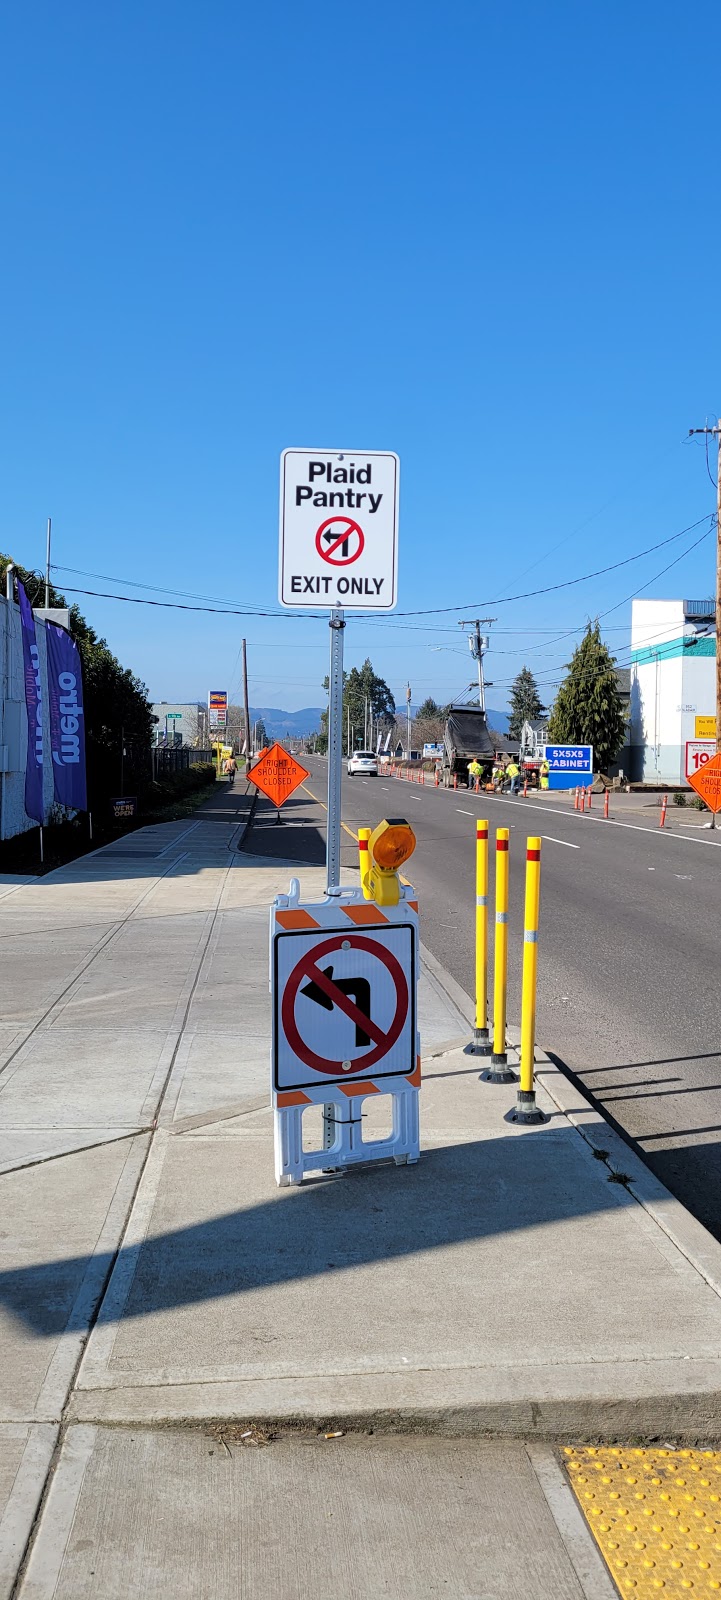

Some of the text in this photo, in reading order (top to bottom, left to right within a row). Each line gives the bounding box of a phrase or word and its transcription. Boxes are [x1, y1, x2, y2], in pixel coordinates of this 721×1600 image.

[308, 461, 372, 484] Plaid
[295, 485, 383, 514] Pantry
[290, 575, 385, 596] EXIT ONLY
[552, 750, 584, 758] 5X5X5
[266, 759, 288, 767] RIGHT
[547, 759, 590, 768] CABINET
[257, 767, 297, 776] SHOULDER
[263, 777, 292, 786] CLOSED
